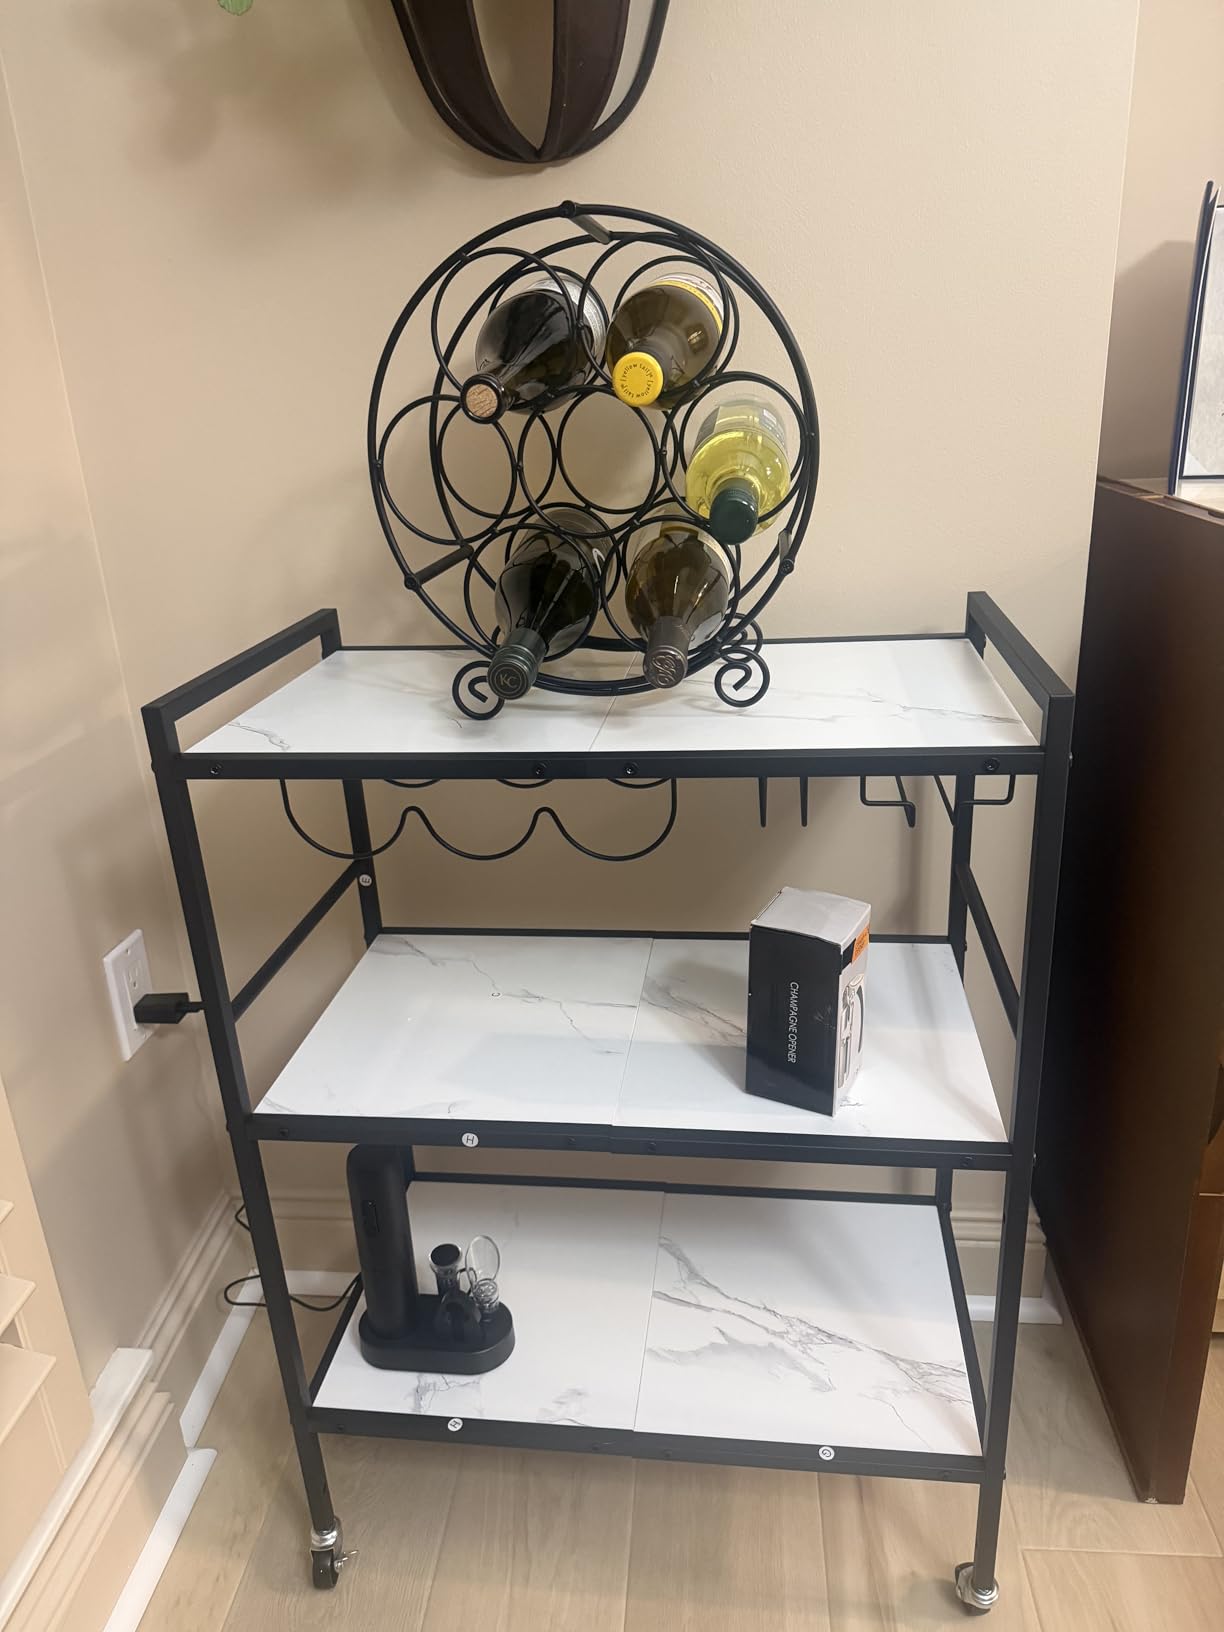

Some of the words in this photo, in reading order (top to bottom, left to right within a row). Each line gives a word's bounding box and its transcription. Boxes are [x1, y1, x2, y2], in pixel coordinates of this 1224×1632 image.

[499, 673, 518, 689] KC
[789, 981, 800, 1034] CHAMPAGNE
[787, 1033, 798, 1064] OPENER
